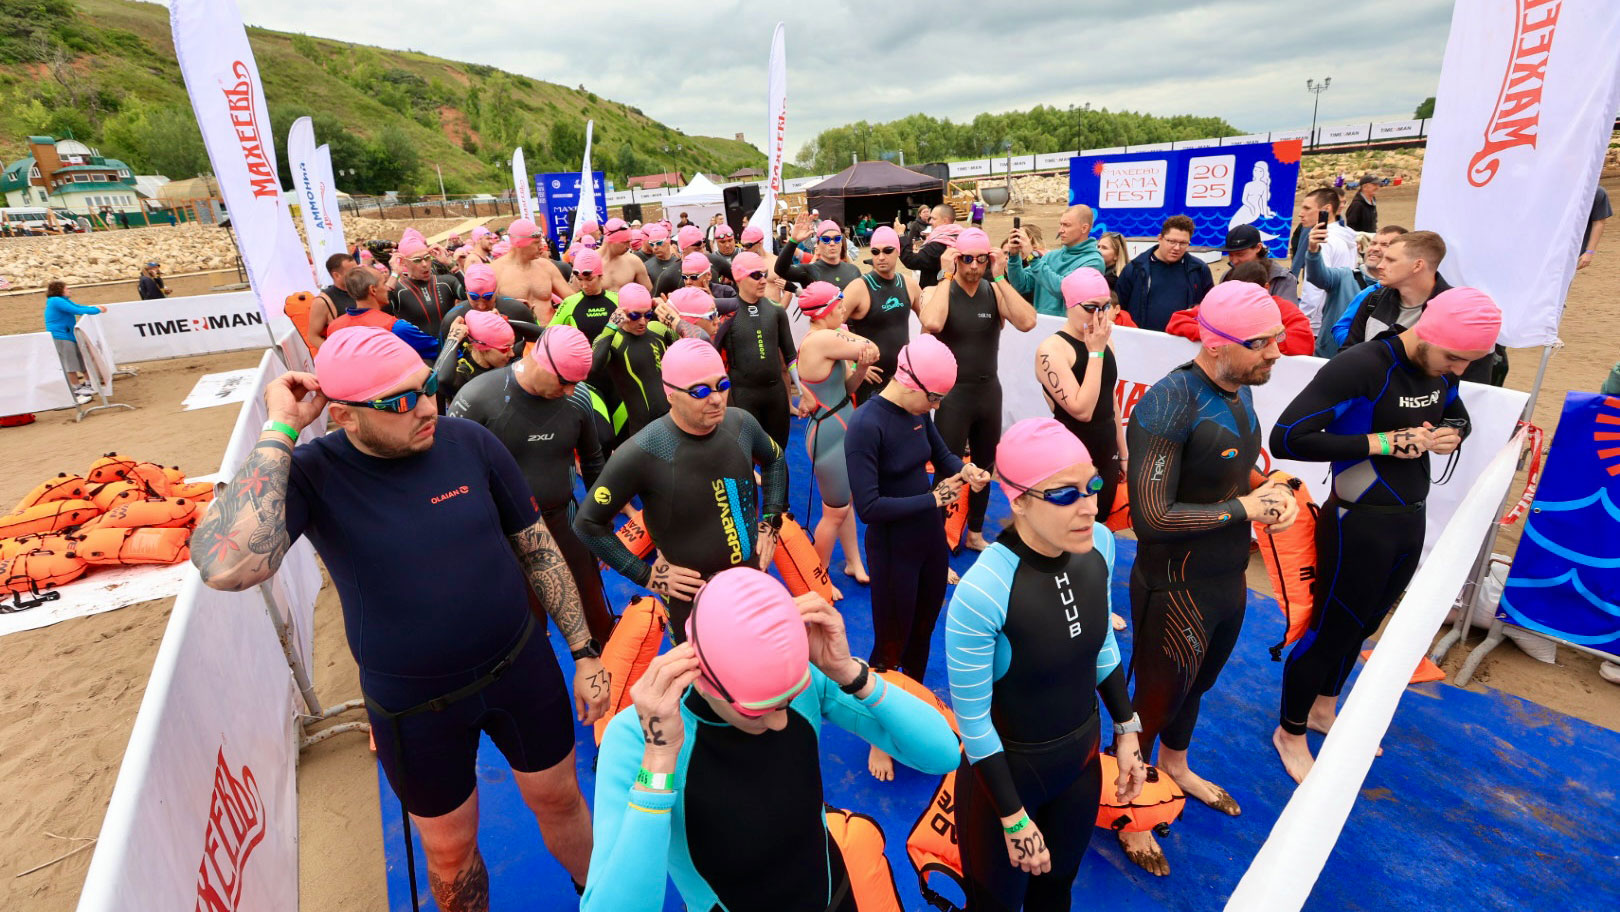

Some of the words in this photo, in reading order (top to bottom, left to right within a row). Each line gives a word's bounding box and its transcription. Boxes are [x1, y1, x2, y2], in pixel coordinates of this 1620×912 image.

[222, 60, 278, 199] МАХЕЕВЪ
[1193, 164, 1229, 180] 20
[1105, 190, 1158, 202] FEST
[1191, 183, 1227, 199] 25
[1040, 354, 1069, 406] 307
[527, 432, 555, 442] 2XU
[1151, 454, 1167, 481] helix
[430, 489, 461, 505] OLAIAN
[711, 478, 743, 565] SUMARPO
[652, 564, 670, 593] 316
[1054, 572, 1082, 639] HUUB
[1182, 627, 1202, 656] helix
[1011, 831, 1046, 860] 302
